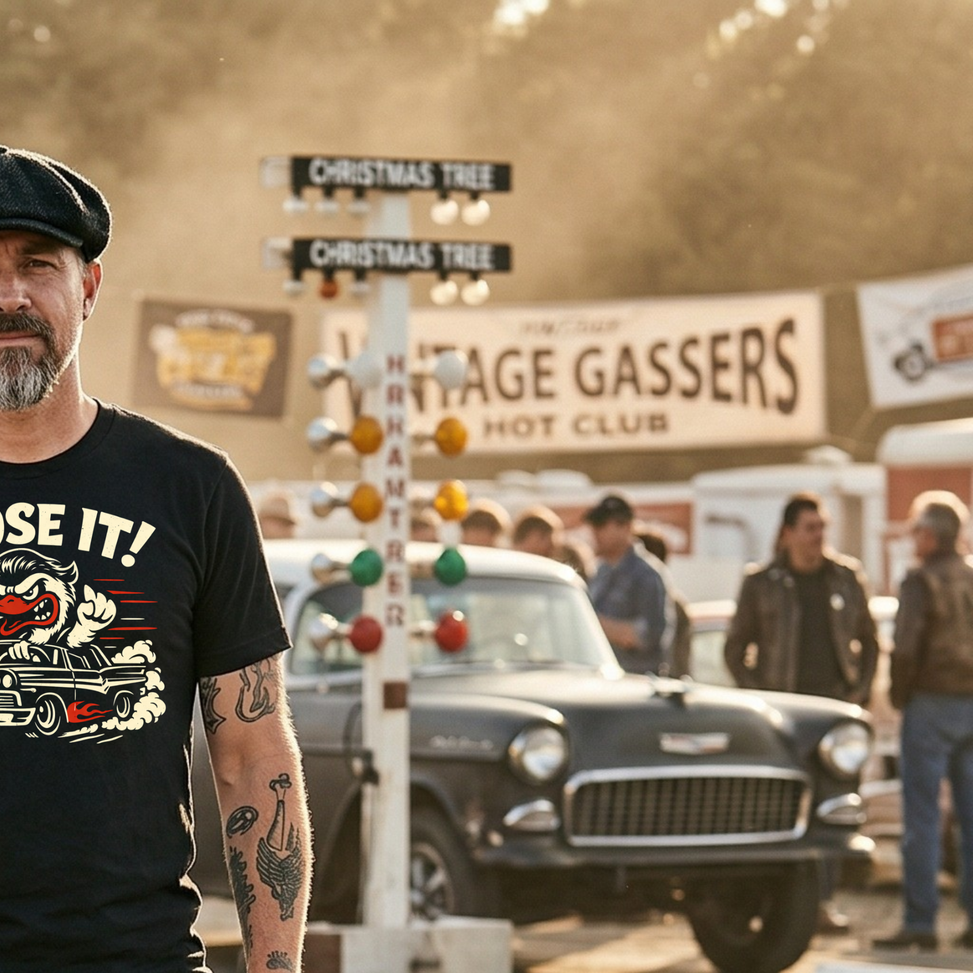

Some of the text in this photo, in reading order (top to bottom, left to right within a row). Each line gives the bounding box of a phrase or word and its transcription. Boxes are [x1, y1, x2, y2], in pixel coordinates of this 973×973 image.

[308, 157, 495, 190] CHRISTMAS TREE
[308, 239, 495, 271] CHRISTMAS TREE
[574, 318, 799, 415] GASSERS
[483, 411, 669, 439] HOT CLUB
[77, 507, 157, 568] IT!
